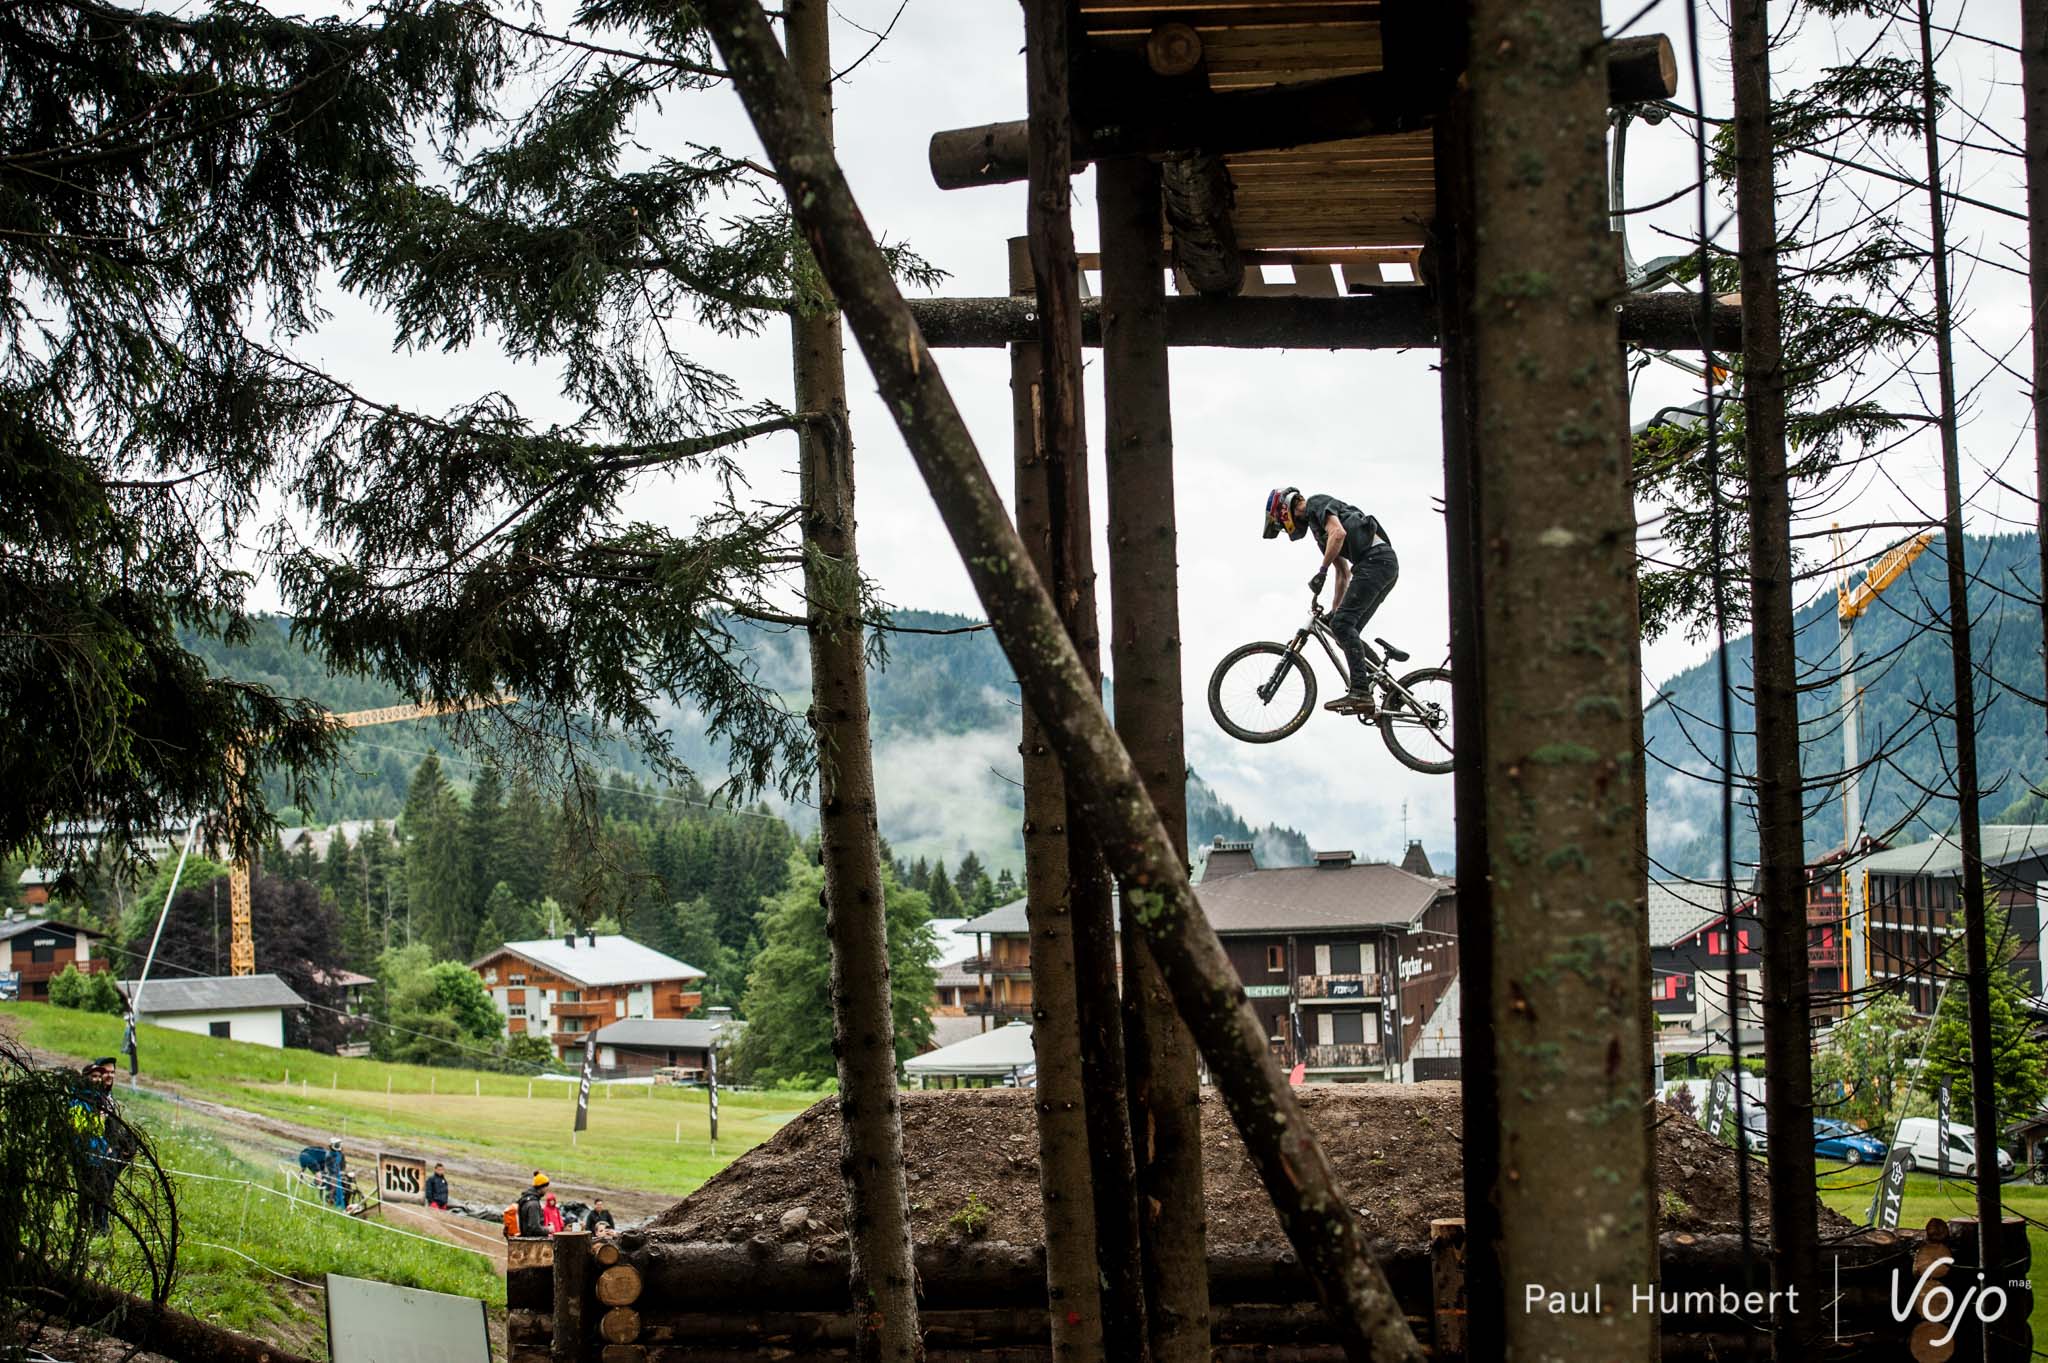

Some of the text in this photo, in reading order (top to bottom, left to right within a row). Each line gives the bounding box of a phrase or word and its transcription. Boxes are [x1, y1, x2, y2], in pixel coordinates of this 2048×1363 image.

[579, 1062, 592, 1109] FOX
[1710, 1104, 1724, 1136] OX
[1941, 1110, 1949, 1155] FOX
[1882, 1187, 1900, 1231] OX
